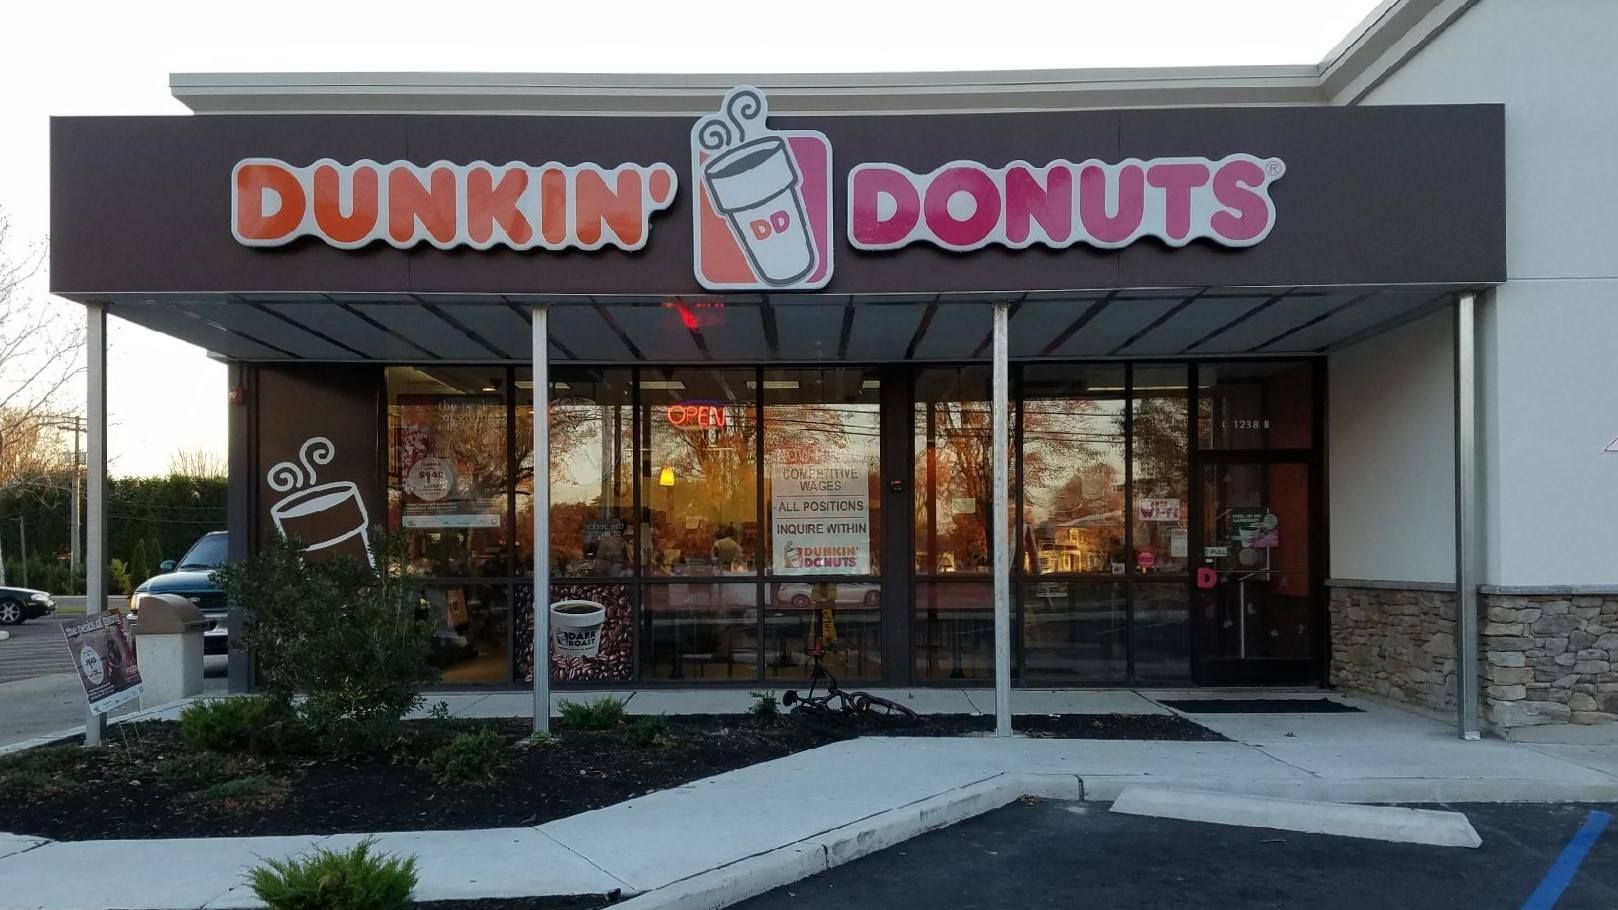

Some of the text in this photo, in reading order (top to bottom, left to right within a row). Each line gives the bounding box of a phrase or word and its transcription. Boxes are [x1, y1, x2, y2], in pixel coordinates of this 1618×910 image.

[237, 164, 671, 245] DUNKIN'
[667, 405, 725, 427] OPEN
[1234, 420, 1259, 429] 1238
[783, 468, 858, 480] COMPETITIVE
[799, 480, 842, 492] WAGES
[778, 500, 865, 513] ALL POSITIONS
[776, 523, 867, 535] INQUIRE WITHIN
[568, 629, 596, 640] DARK
[568, 638, 596, 648] ROAST
